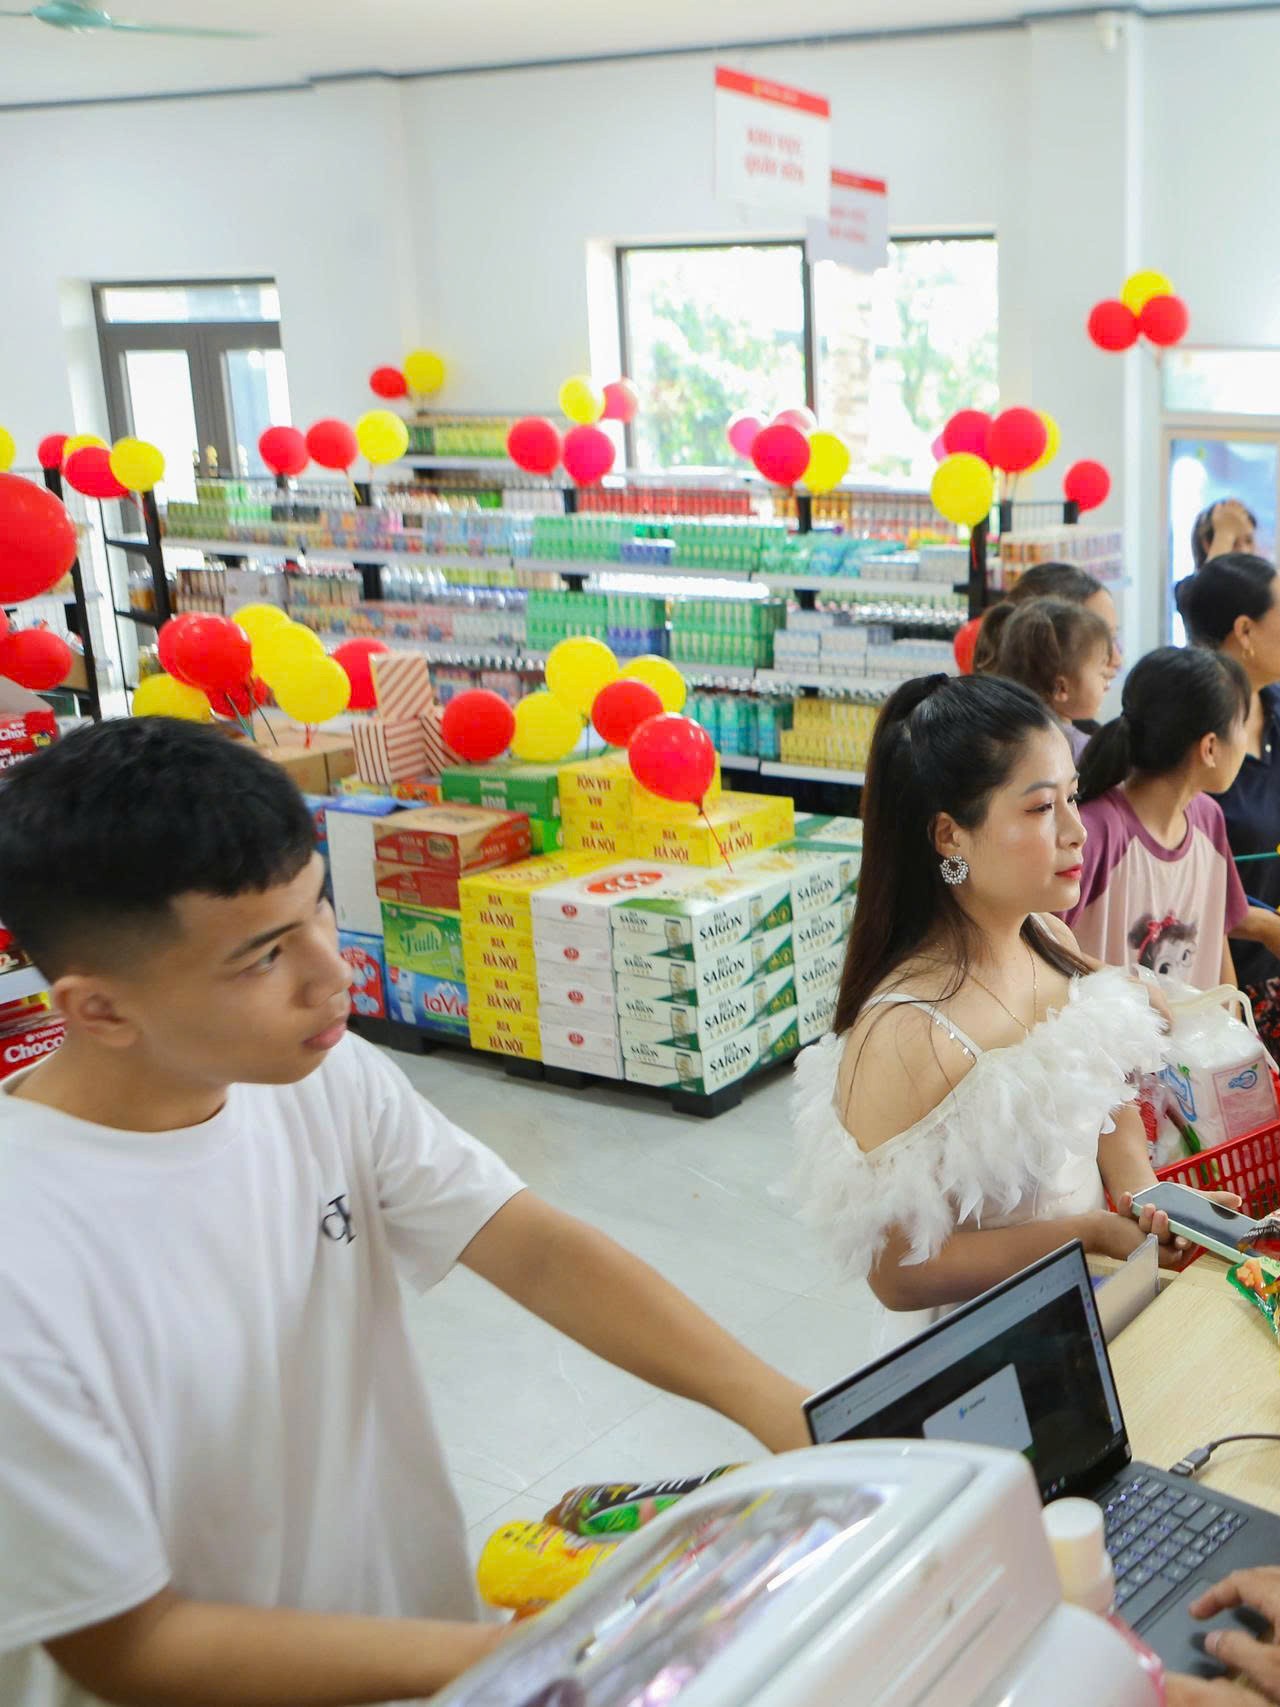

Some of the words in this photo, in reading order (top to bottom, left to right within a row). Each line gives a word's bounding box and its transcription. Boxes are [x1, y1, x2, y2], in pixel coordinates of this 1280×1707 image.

[699, 915, 743, 941] SAIGON
[703, 958, 745, 985] SAIGON
[704, 1003, 747, 1028] SAIGON
[4, 1036, 64, 1063] Choco
[709, 1045, 752, 1072] SAIGON
